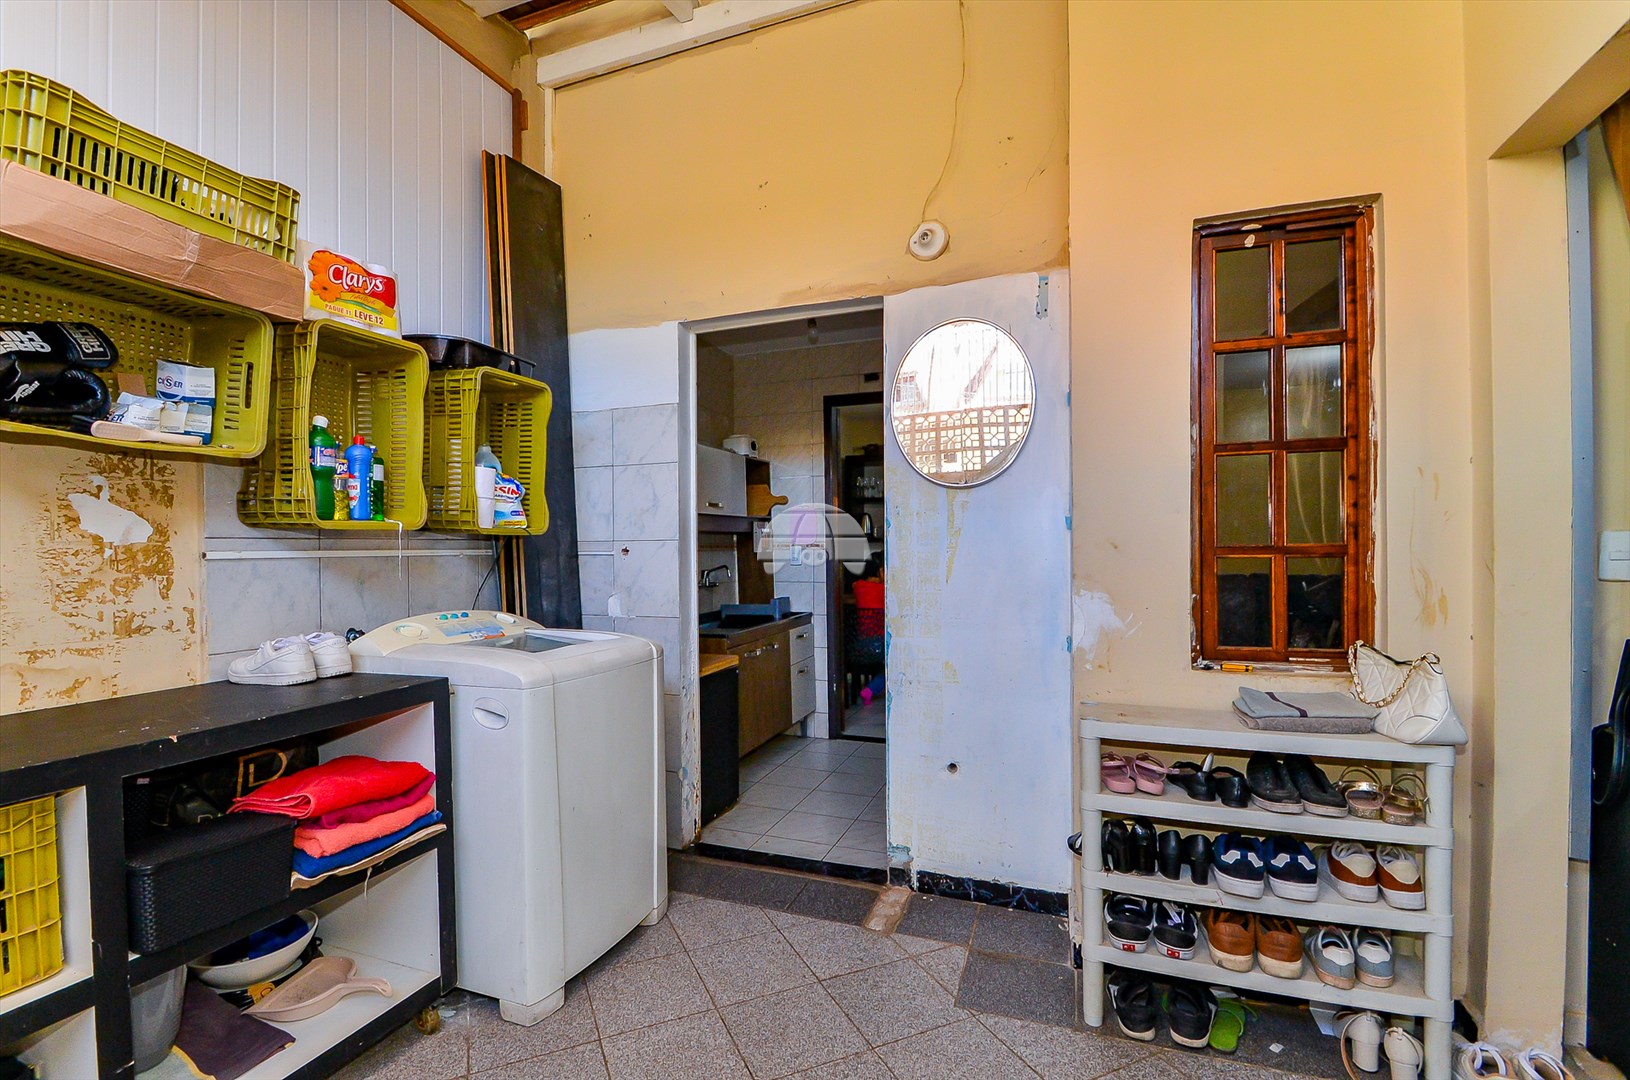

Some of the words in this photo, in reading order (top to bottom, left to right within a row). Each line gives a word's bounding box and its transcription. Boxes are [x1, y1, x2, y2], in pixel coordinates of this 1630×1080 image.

[328, 263, 384, 294] Clarys
[354, 309, 374, 323] LEVE
[374, 315, 384, 326] 12
[157, 375, 183, 390] CISER
